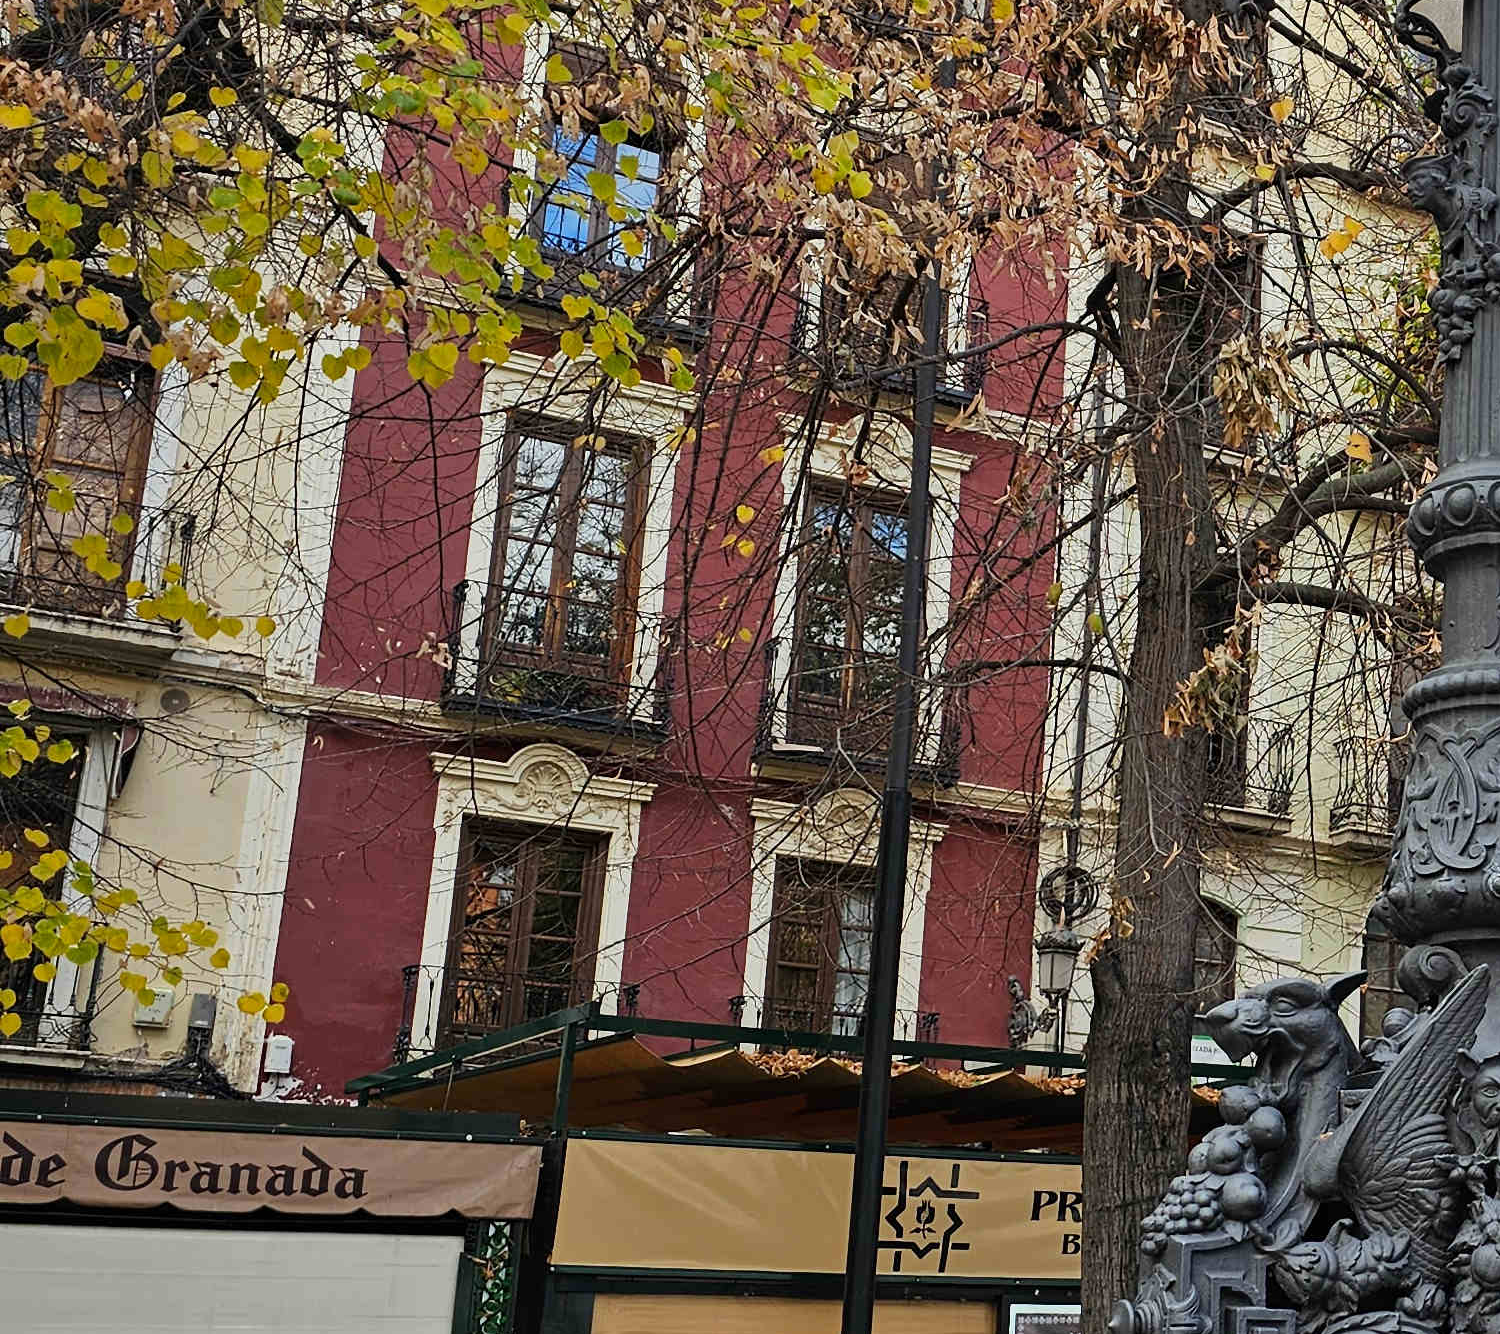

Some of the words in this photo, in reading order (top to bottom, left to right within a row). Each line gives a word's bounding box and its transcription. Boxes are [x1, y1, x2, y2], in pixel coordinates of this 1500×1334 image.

[0, 1130, 67, 1188] de
[95, 1133, 369, 1200] Granada
[1030, 1190, 1082, 1222] PR
[1061, 1233, 1081, 1255] B
